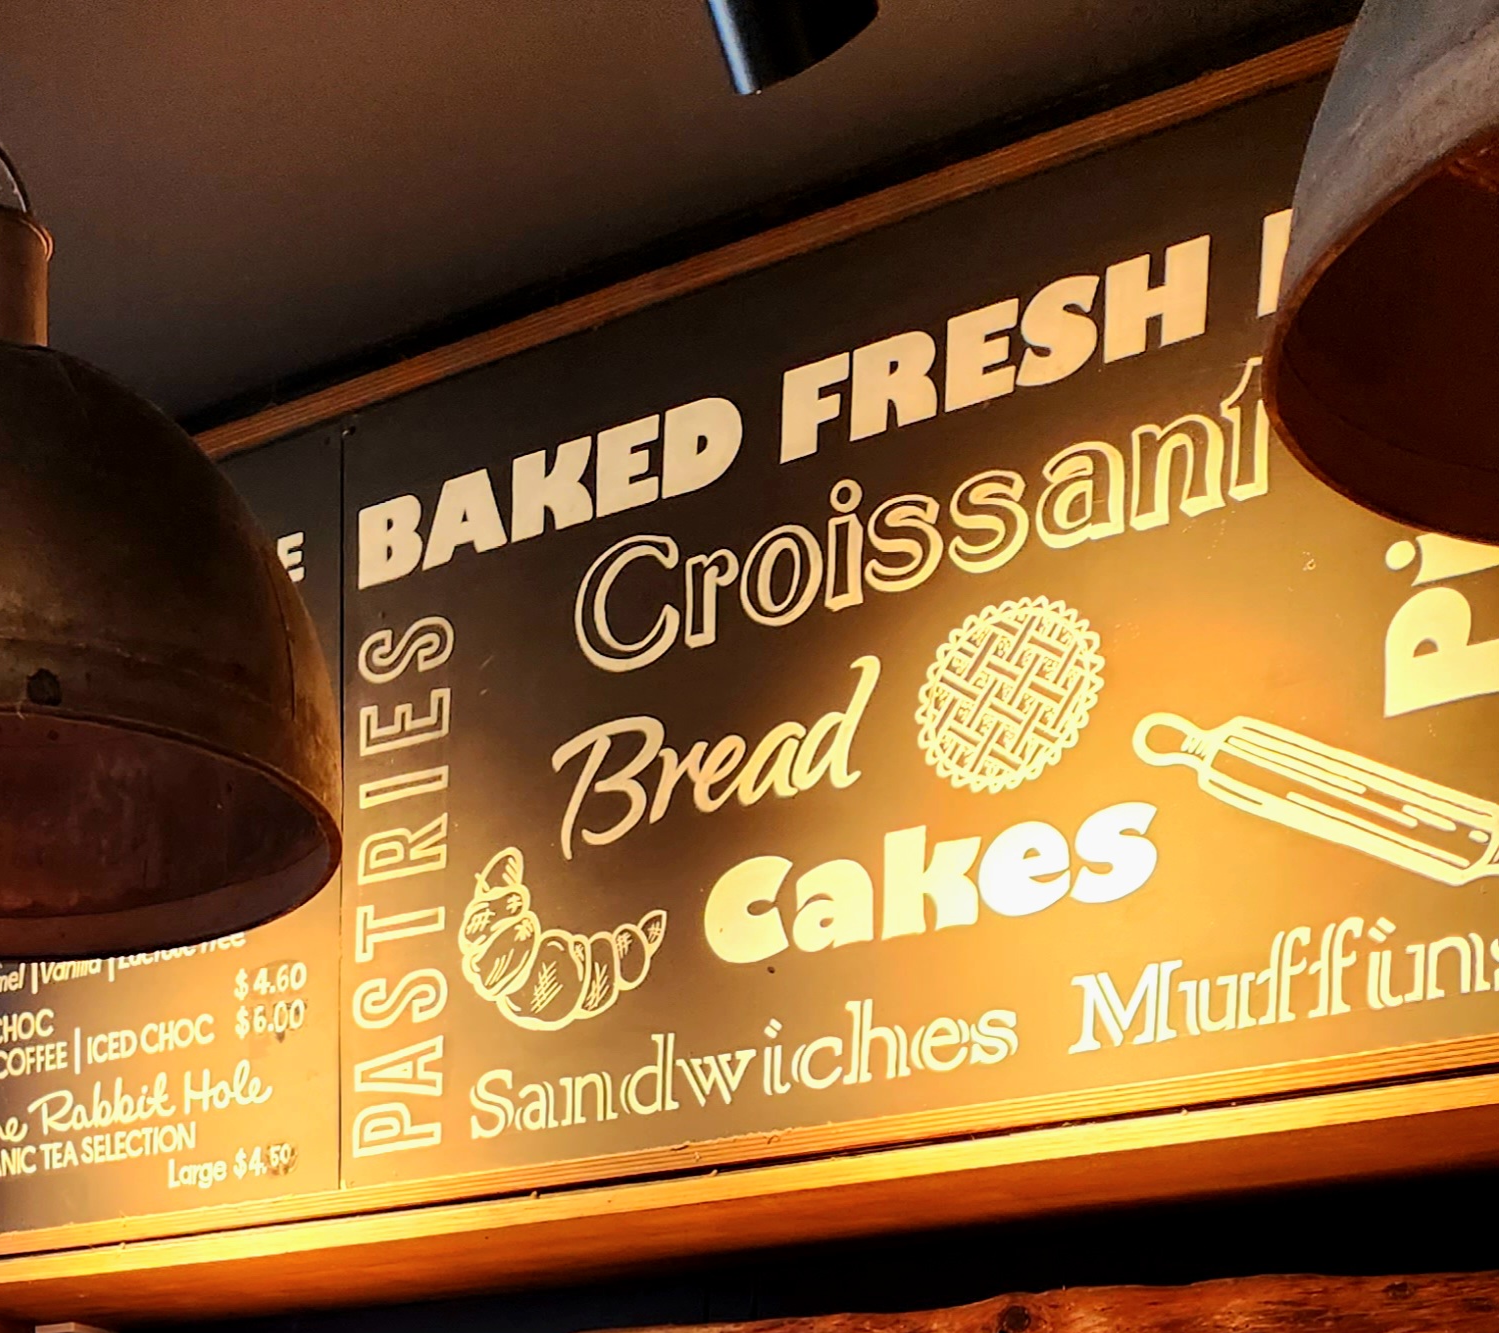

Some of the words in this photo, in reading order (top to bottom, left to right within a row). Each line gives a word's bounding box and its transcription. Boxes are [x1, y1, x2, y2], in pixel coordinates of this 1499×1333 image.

[358, 396, 744, 589] BAKED
[779, 234, 1211, 465] FRESH
[551, 655, 883, 861] Bread
[352, 616, 455, 1159] PASTRIES
[703, 800, 1160, 965] Cakes
[233, 960, 309, 1002] $4.60
[86, 1026, 141, 1063] ICED
[141, 1013, 216, 1055] CHOC
[468, 997, 1019, 1141] Sandwiches
[27, 1071, 176, 1138] Rabbit
[183, 1058, 274, 1116] Hole
[39, 1140, 80, 1172] TEA
[80, 1121, 197, 1165] SELECTION
[167, 1157, 229, 1190] Large
